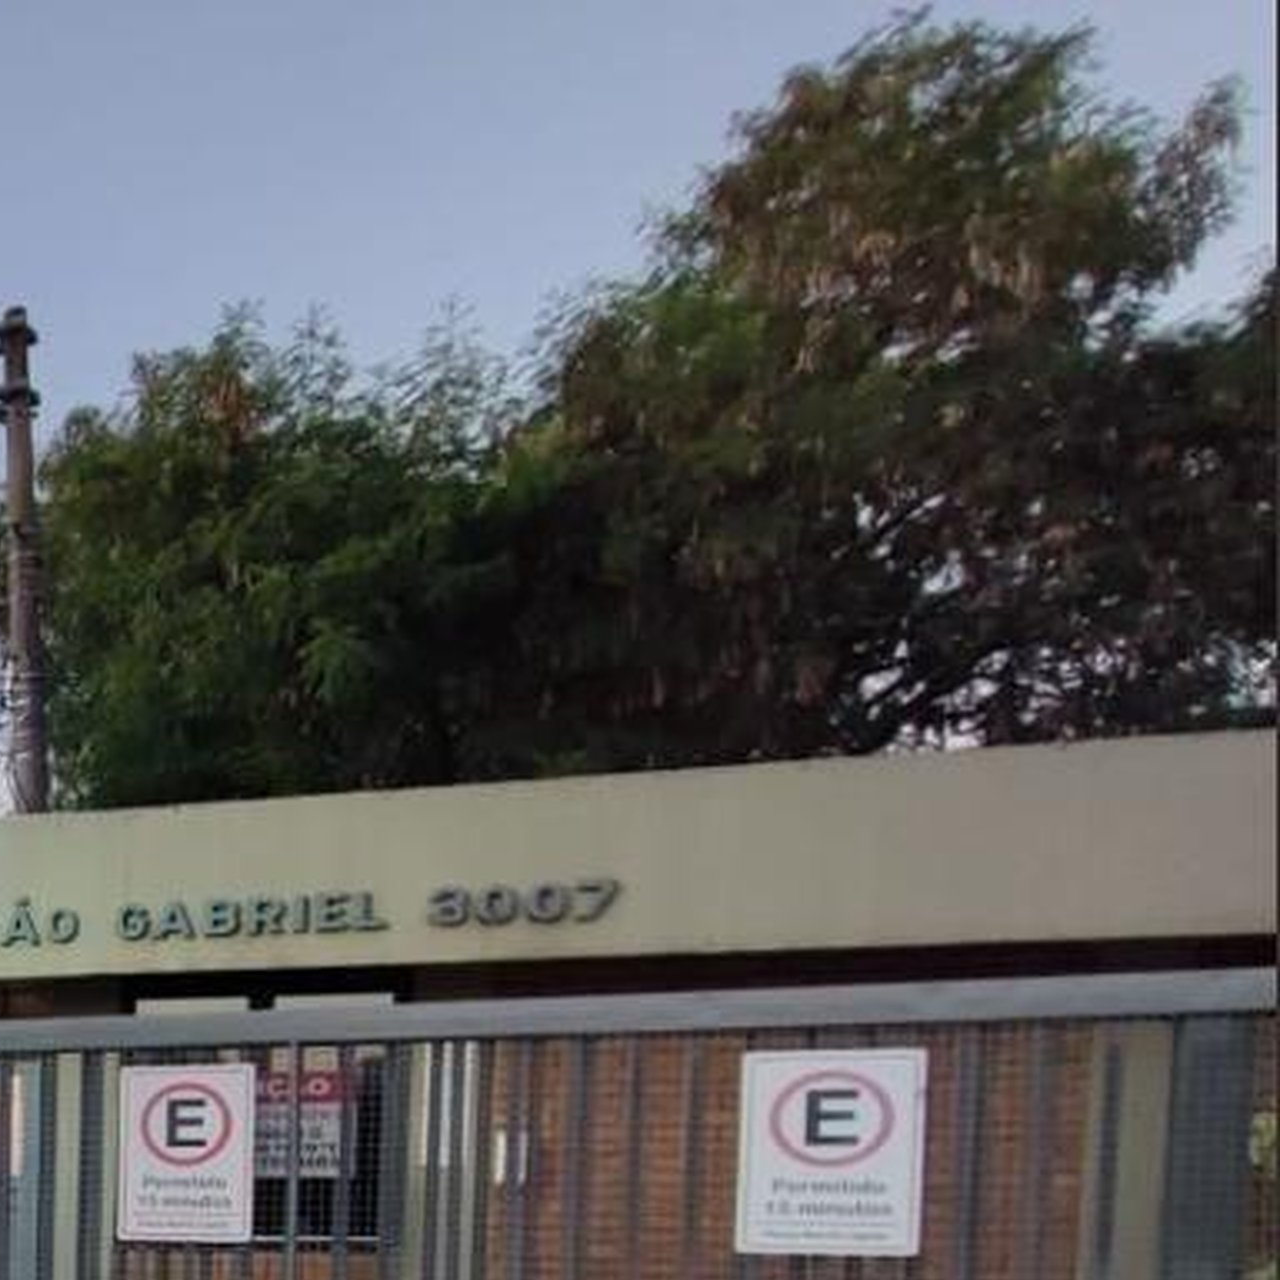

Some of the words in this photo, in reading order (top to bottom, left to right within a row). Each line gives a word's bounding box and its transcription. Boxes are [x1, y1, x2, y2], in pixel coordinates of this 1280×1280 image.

[115, 889, 393, 943] GABRIEL
[164, 1097, 209, 1148] E
[804, 1088, 861, 1147] E
